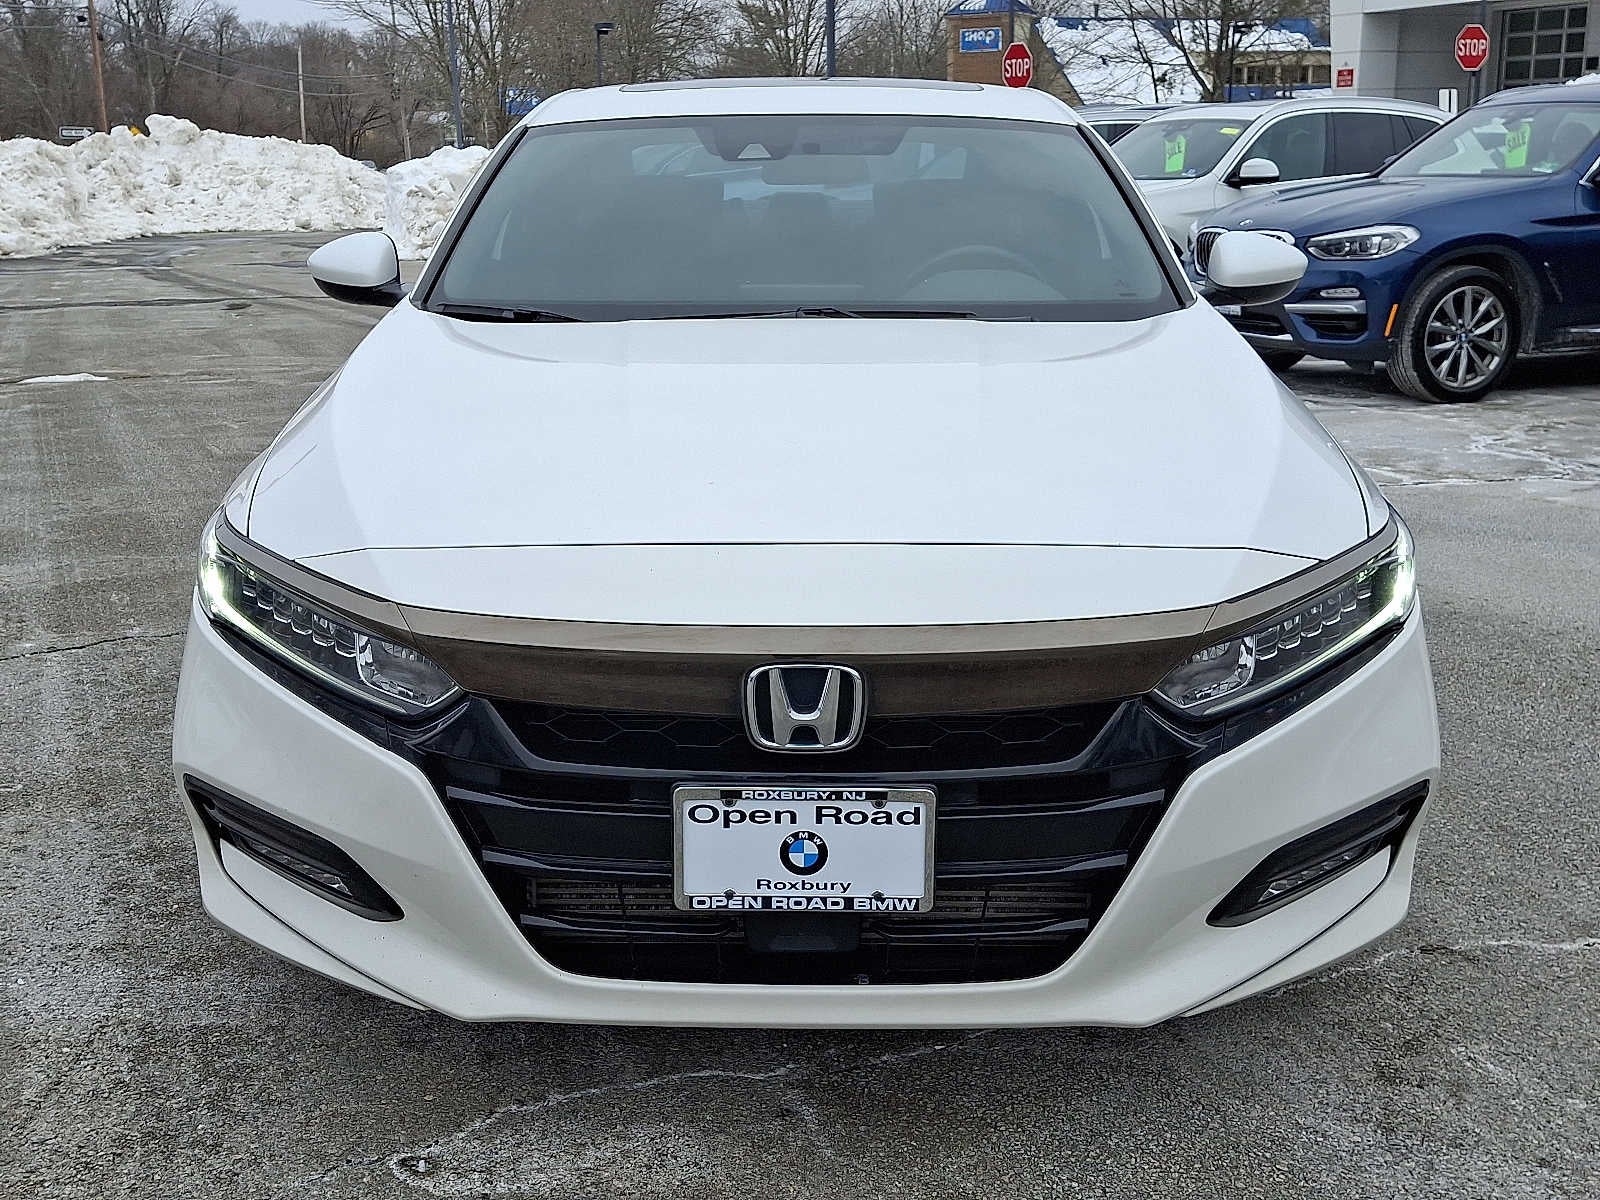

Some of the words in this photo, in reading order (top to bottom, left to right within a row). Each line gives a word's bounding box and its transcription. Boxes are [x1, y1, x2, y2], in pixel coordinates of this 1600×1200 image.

[1458, 38, 1487, 57] STOP
[1004, 58, 1030, 78] STOP
[741, 790, 836, 800] ROXBURY,
[842, 791, 866, 800] NJ
[687, 804, 797, 828] Open
[815, 805, 921, 826] Road
[786, 832, 823, 845] BMW
[756, 878, 852, 894] Roxbury
[692, 896, 763, 909] OPEN
[771, 897, 845, 910] ROAD
[853, 898, 916, 911] BMW
